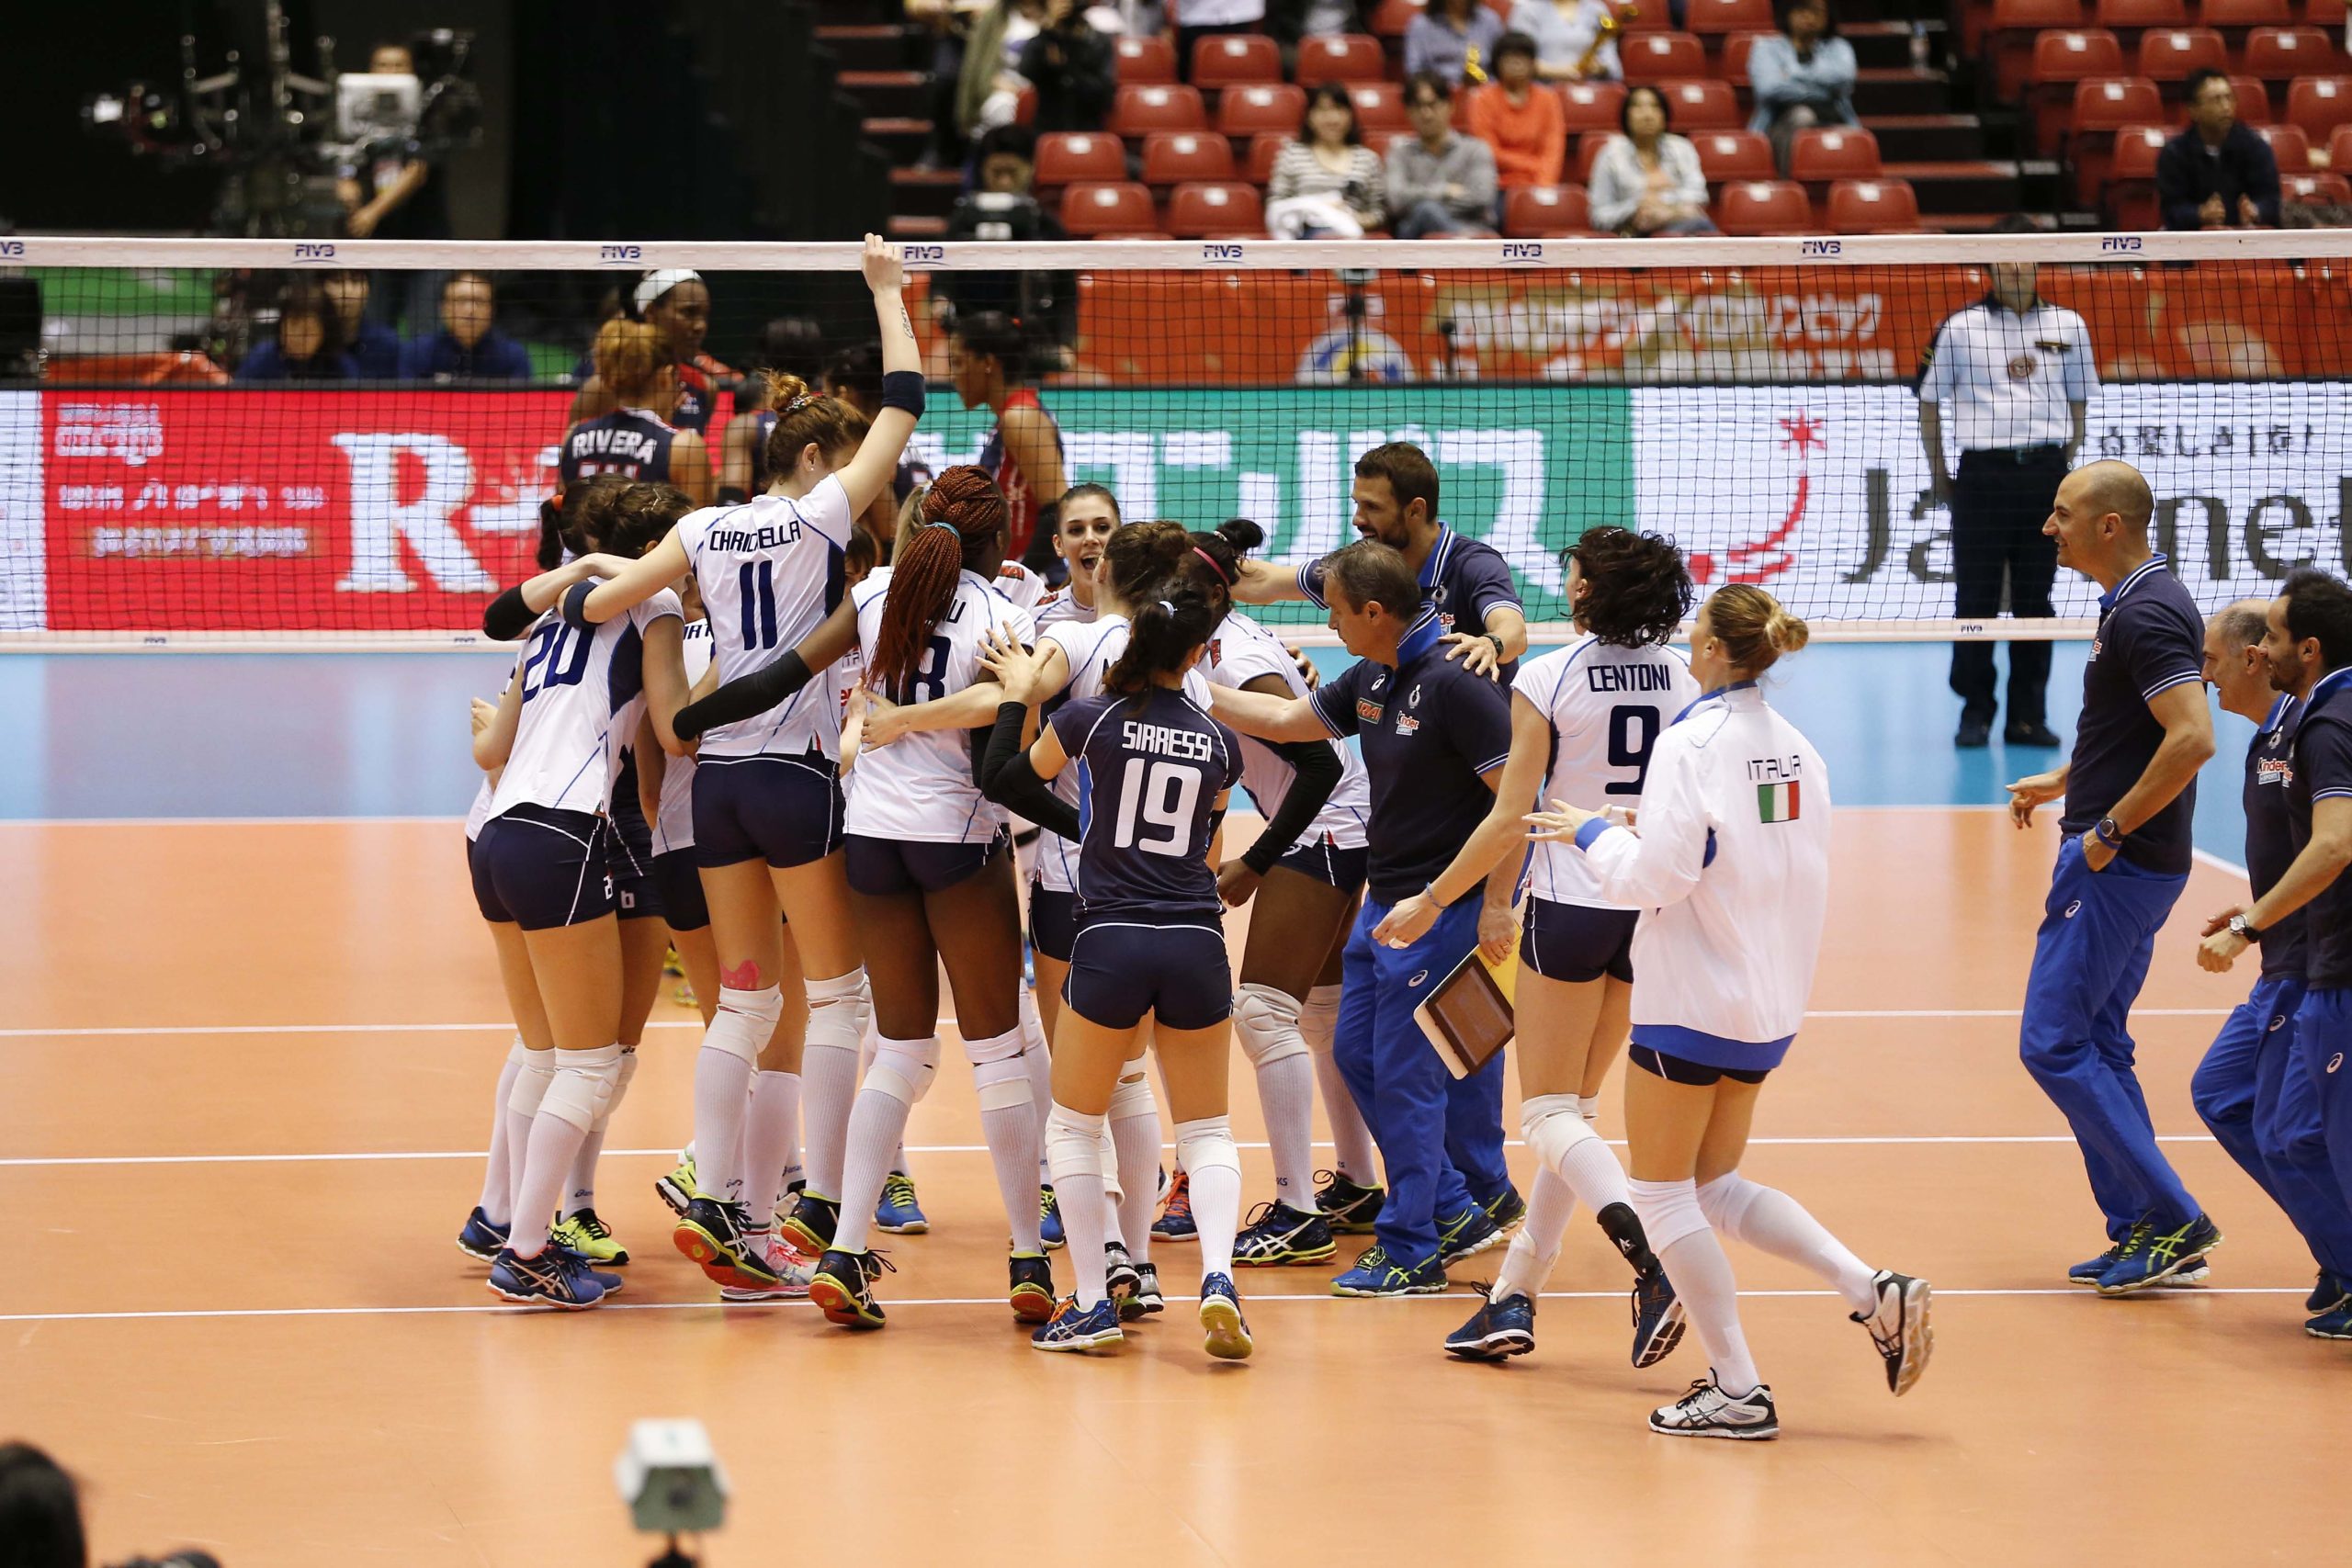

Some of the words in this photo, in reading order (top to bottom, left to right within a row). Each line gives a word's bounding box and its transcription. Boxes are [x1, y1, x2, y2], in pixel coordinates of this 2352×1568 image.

[0, 242, 24, 256] VB
[295, 243, 334, 257] FIVB
[601, 245, 640, 259] FIVB
[903, 245, 944, 259] FIVB
[1204, 244, 1242, 258] FIVB
[1502, 243, 1543, 257] FIVB
[1803, 241, 1841, 254] FIVB
[2102, 236, 2142, 250] FIVB
[572, 429, 658, 465] RIVERA
[740, 560, 778, 650] 11
[521, 622, 596, 704] 20
[1588, 664, 1671, 692] CENTONI
[1122, 721, 1212, 762] SIRRESSI
[1605, 705, 1660, 795] 9
[1747, 754, 1803, 780] ITALIA
[1114, 758, 1203, 857] 19
